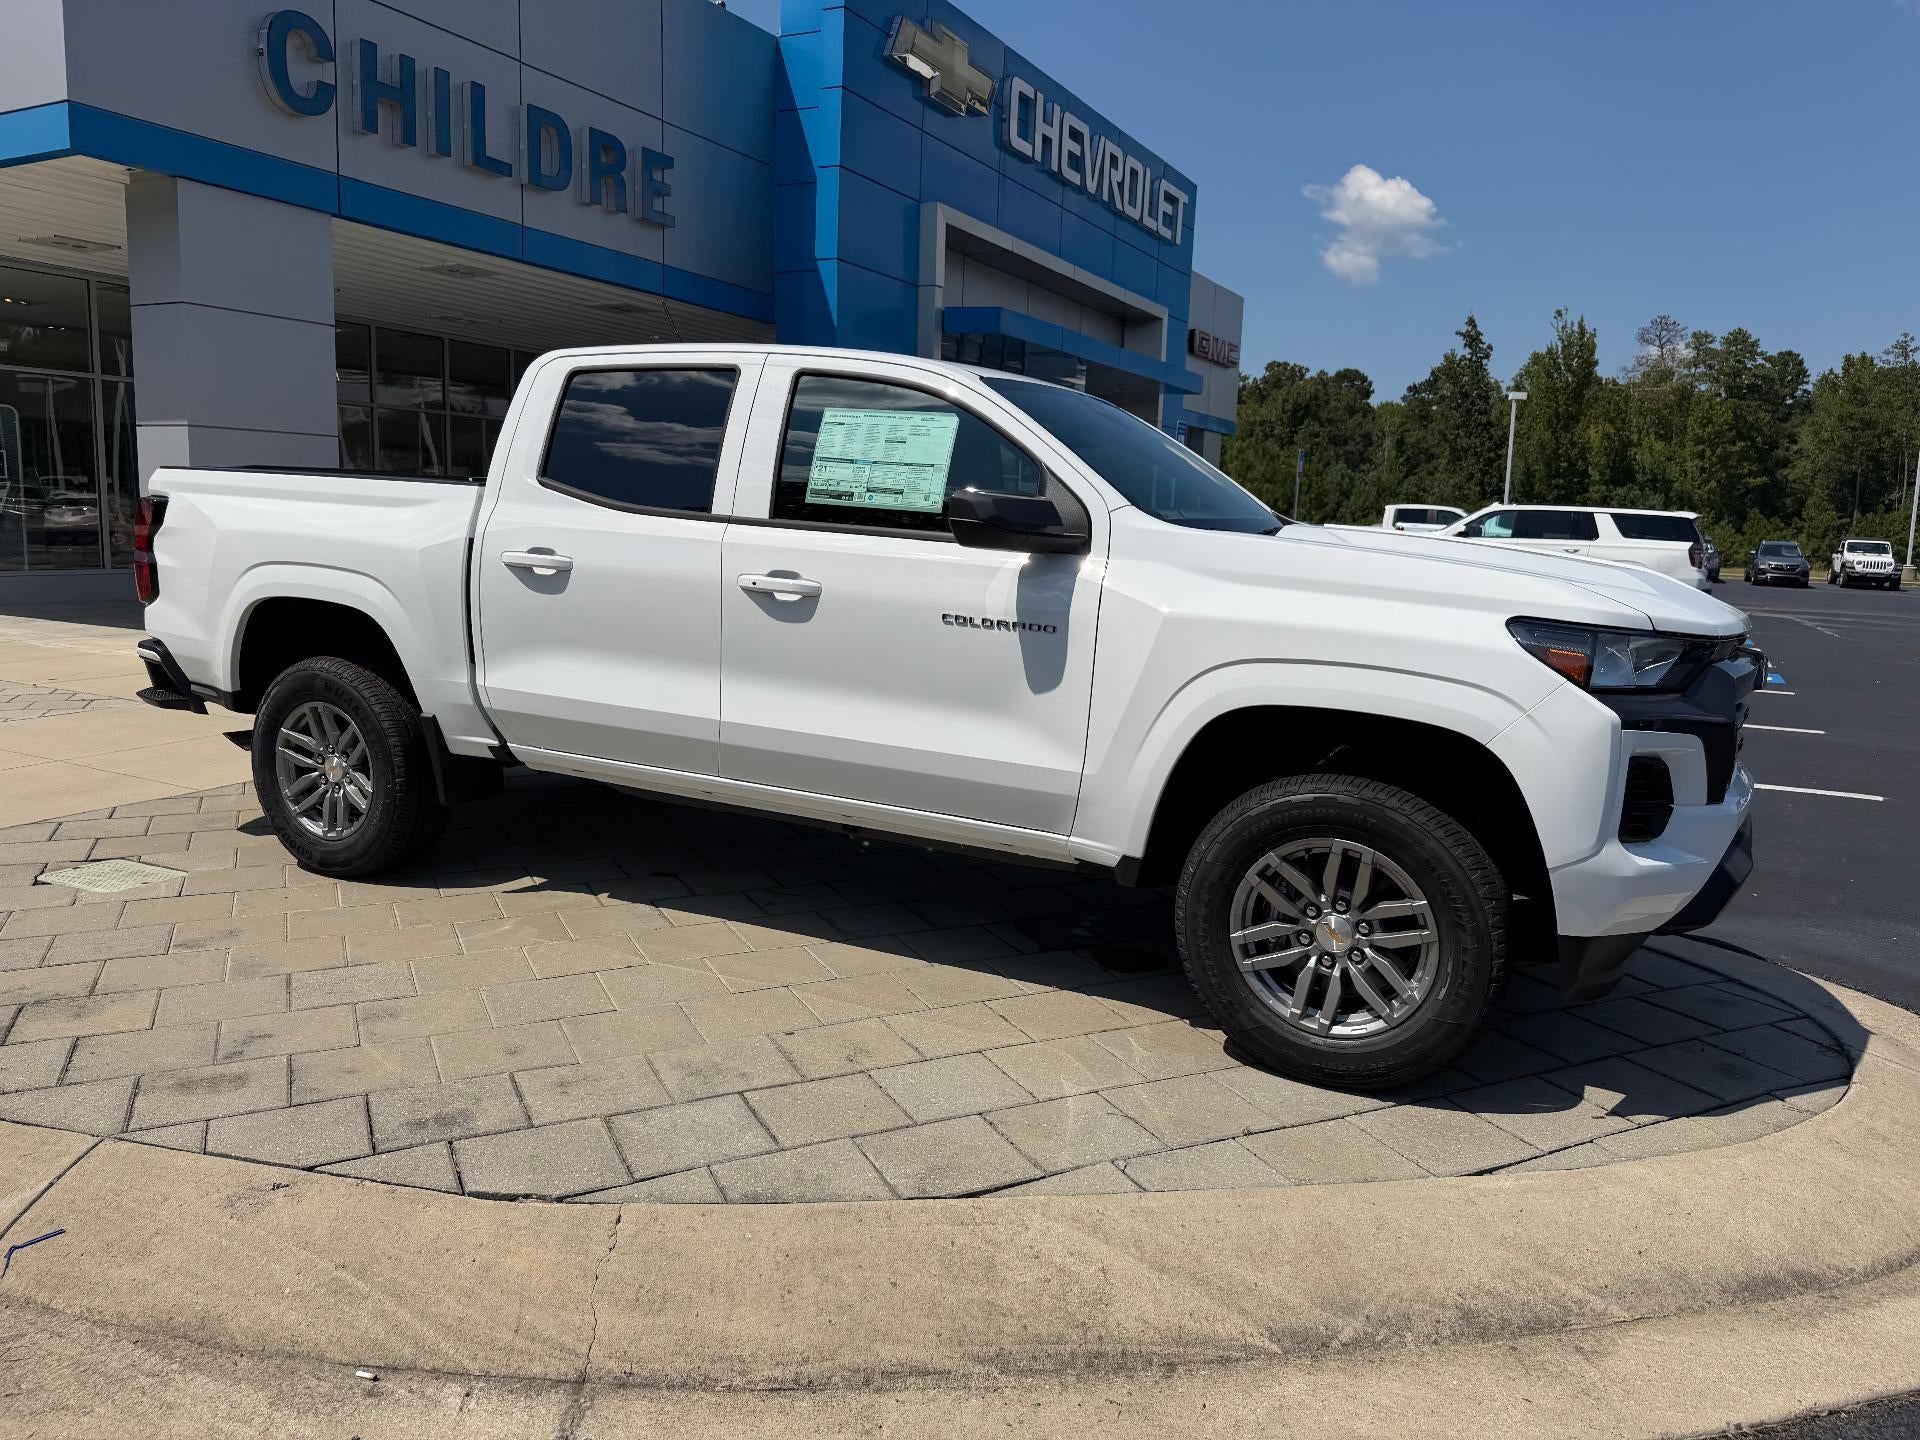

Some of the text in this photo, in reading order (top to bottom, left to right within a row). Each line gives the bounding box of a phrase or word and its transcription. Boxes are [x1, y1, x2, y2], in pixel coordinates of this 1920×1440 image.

[260, 9, 676, 228] CHILDRE
[1008, 75, 1189, 246] CHEVROLET
[1193, 329, 1239, 368] GMC
[941, 613, 1057, 633] COLORADO
